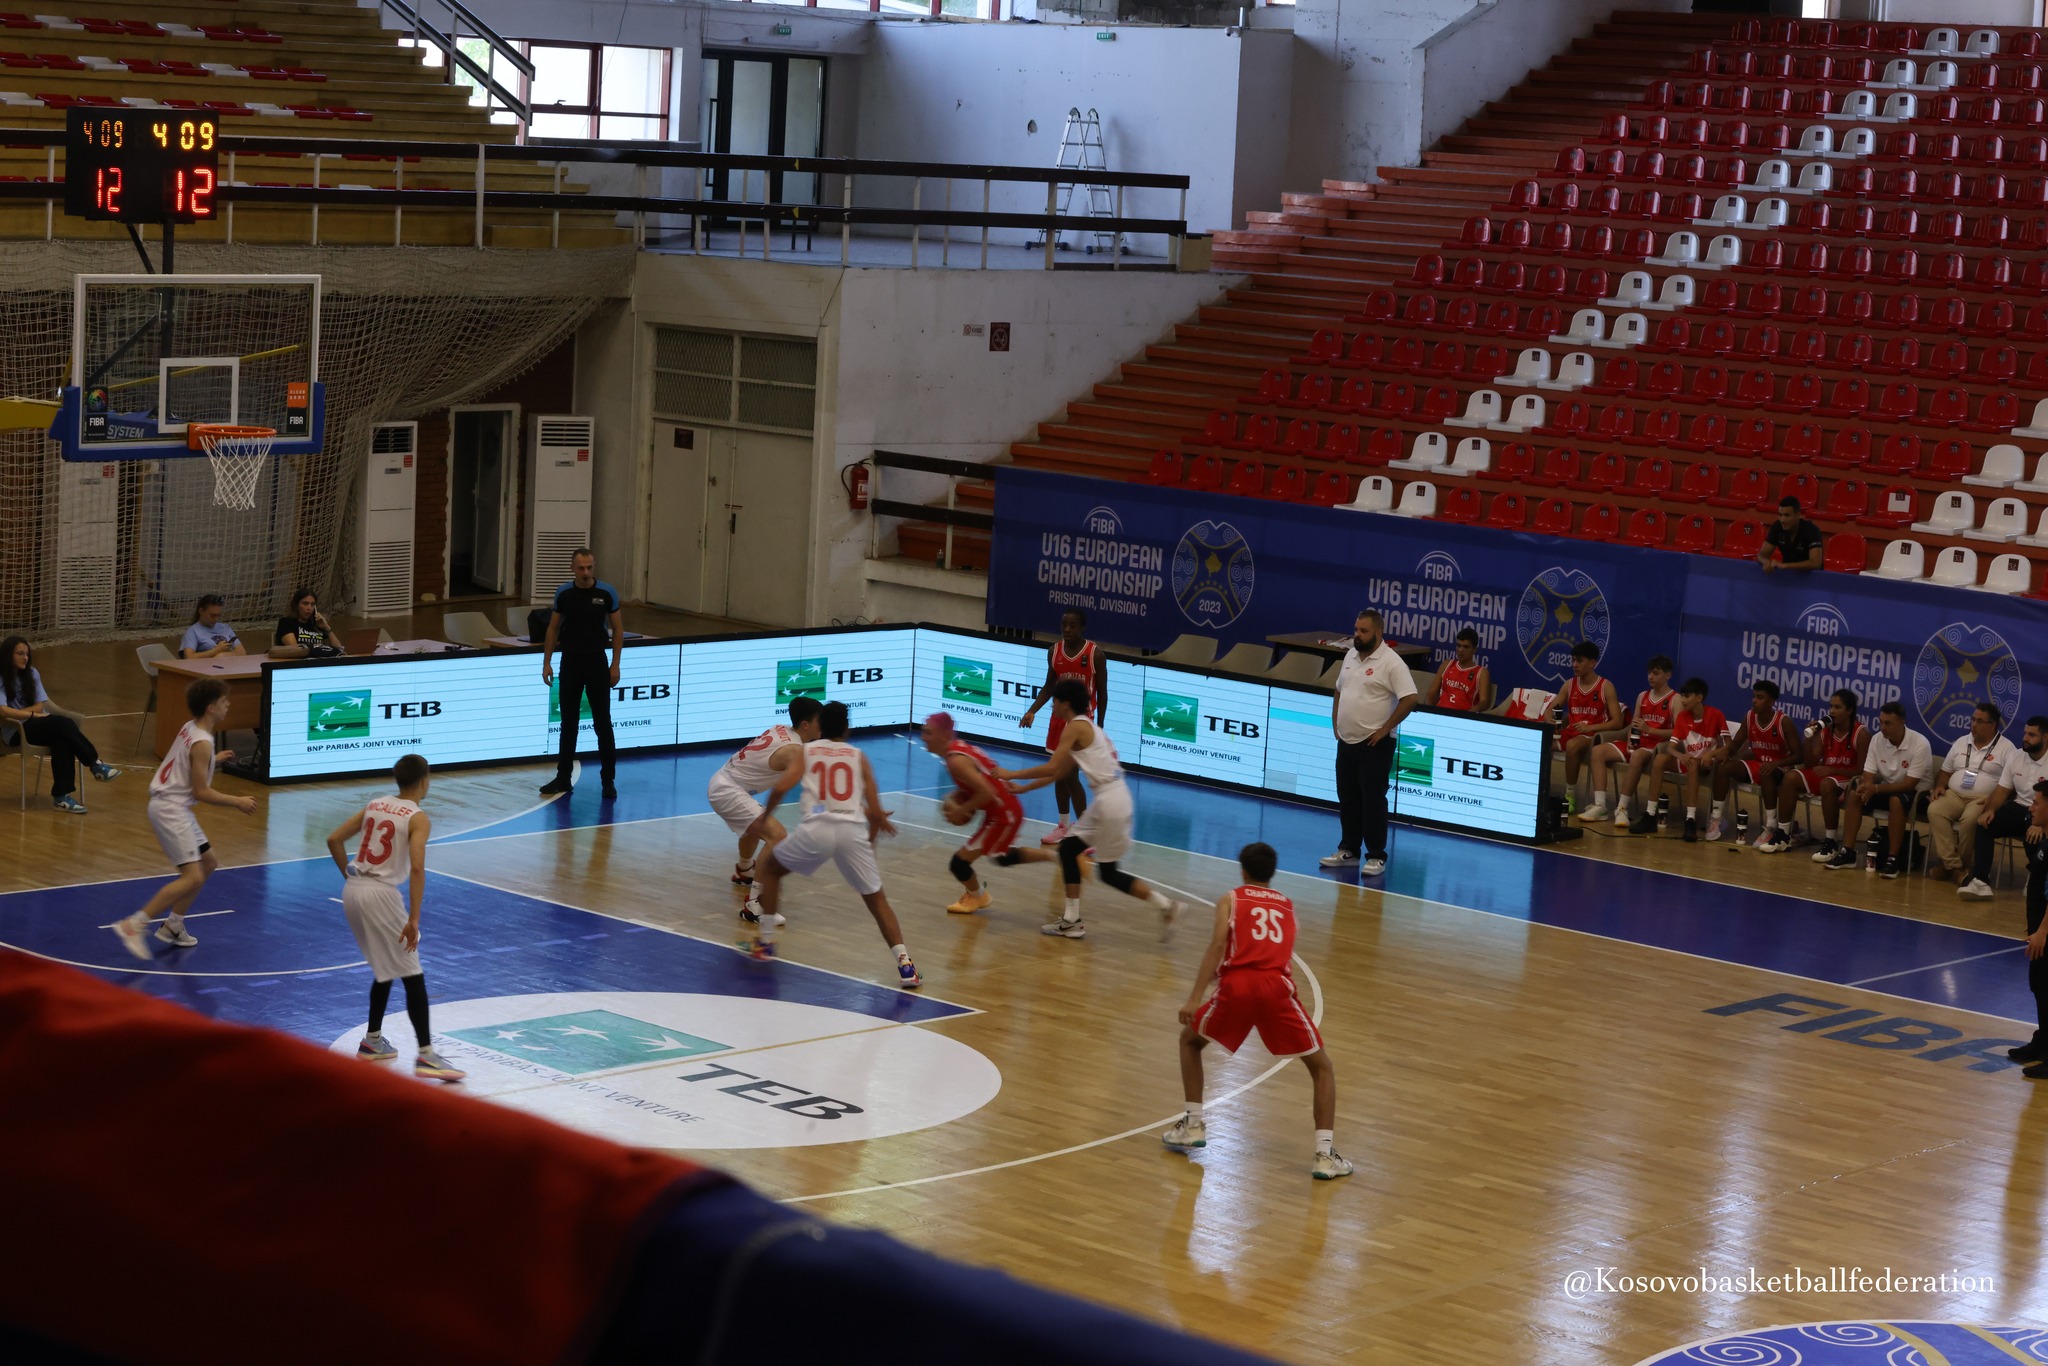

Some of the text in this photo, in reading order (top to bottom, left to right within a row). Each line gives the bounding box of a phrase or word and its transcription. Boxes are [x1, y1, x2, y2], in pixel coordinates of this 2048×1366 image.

[97, 168, 122, 213] 12
[176, 168, 213, 214] 12
[89, 417, 105, 427] FIBA
[107, 424, 145, 439] SYSTEM
[289, 416, 304, 425] FIBA
[1090, 517, 1116, 536] FIBA
[1041, 532, 1163, 571] U16 EUROPEAN
[1038, 559, 1163, 599] CHAMPIONSHIP
[1424, 562, 1453, 582] FIBA
[1049, 590, 1147, 617] PRISHTINA, DIVISION C
[1198, 599, 1222, 614] 2023
[1368, 578, 1506, 622] U16 EUROPEAN
[1367, 608, 1507, 650] HAMPIONHIP
[1806, 615, 1839, 637] FIBA
[1742, 630, 1901, 681] U16 EUROPEAN
[832, 667, 884, 685] TEB
[612, 684, 671, 702] TEB
[1449, 693, 1456, 704] 2
[377, 700, 442, 720] TEB
[941, 702, 955, 710] BNP
[956, 704, 984, 715] PARIBAS
[985, 711, 1003, 719] JOINT
[1949, 713, 1972, 729] 202
[620, 719, 652, 728] VENTURE
[1204, 715, 1260, 739] TEB
[307, 738, 423, 752] BNP PARIBAS JOINT VENTURE
[1141, 738, 1242, 762] BNP PARIBAS JOINT VENTURE
[1440, 756, 1504, 781] TEB
[811, 761, 854, 802] 10
[1424, 790, 1447, 799] JOINT
[1448, 794, 1483, 806] VENTURE
[357, 817, 396, 865] 13
[1250, 906, 1285, 944] 35
[1701, 993, 2032, 1073] FIBA
[455, 1047, 544, 1076] PARIBAS
[540, 1073, 609, 1094] JOINT
[605, 1089, 705, 1124] VENTURE
[676, 1063, 865, 1122] TEB
